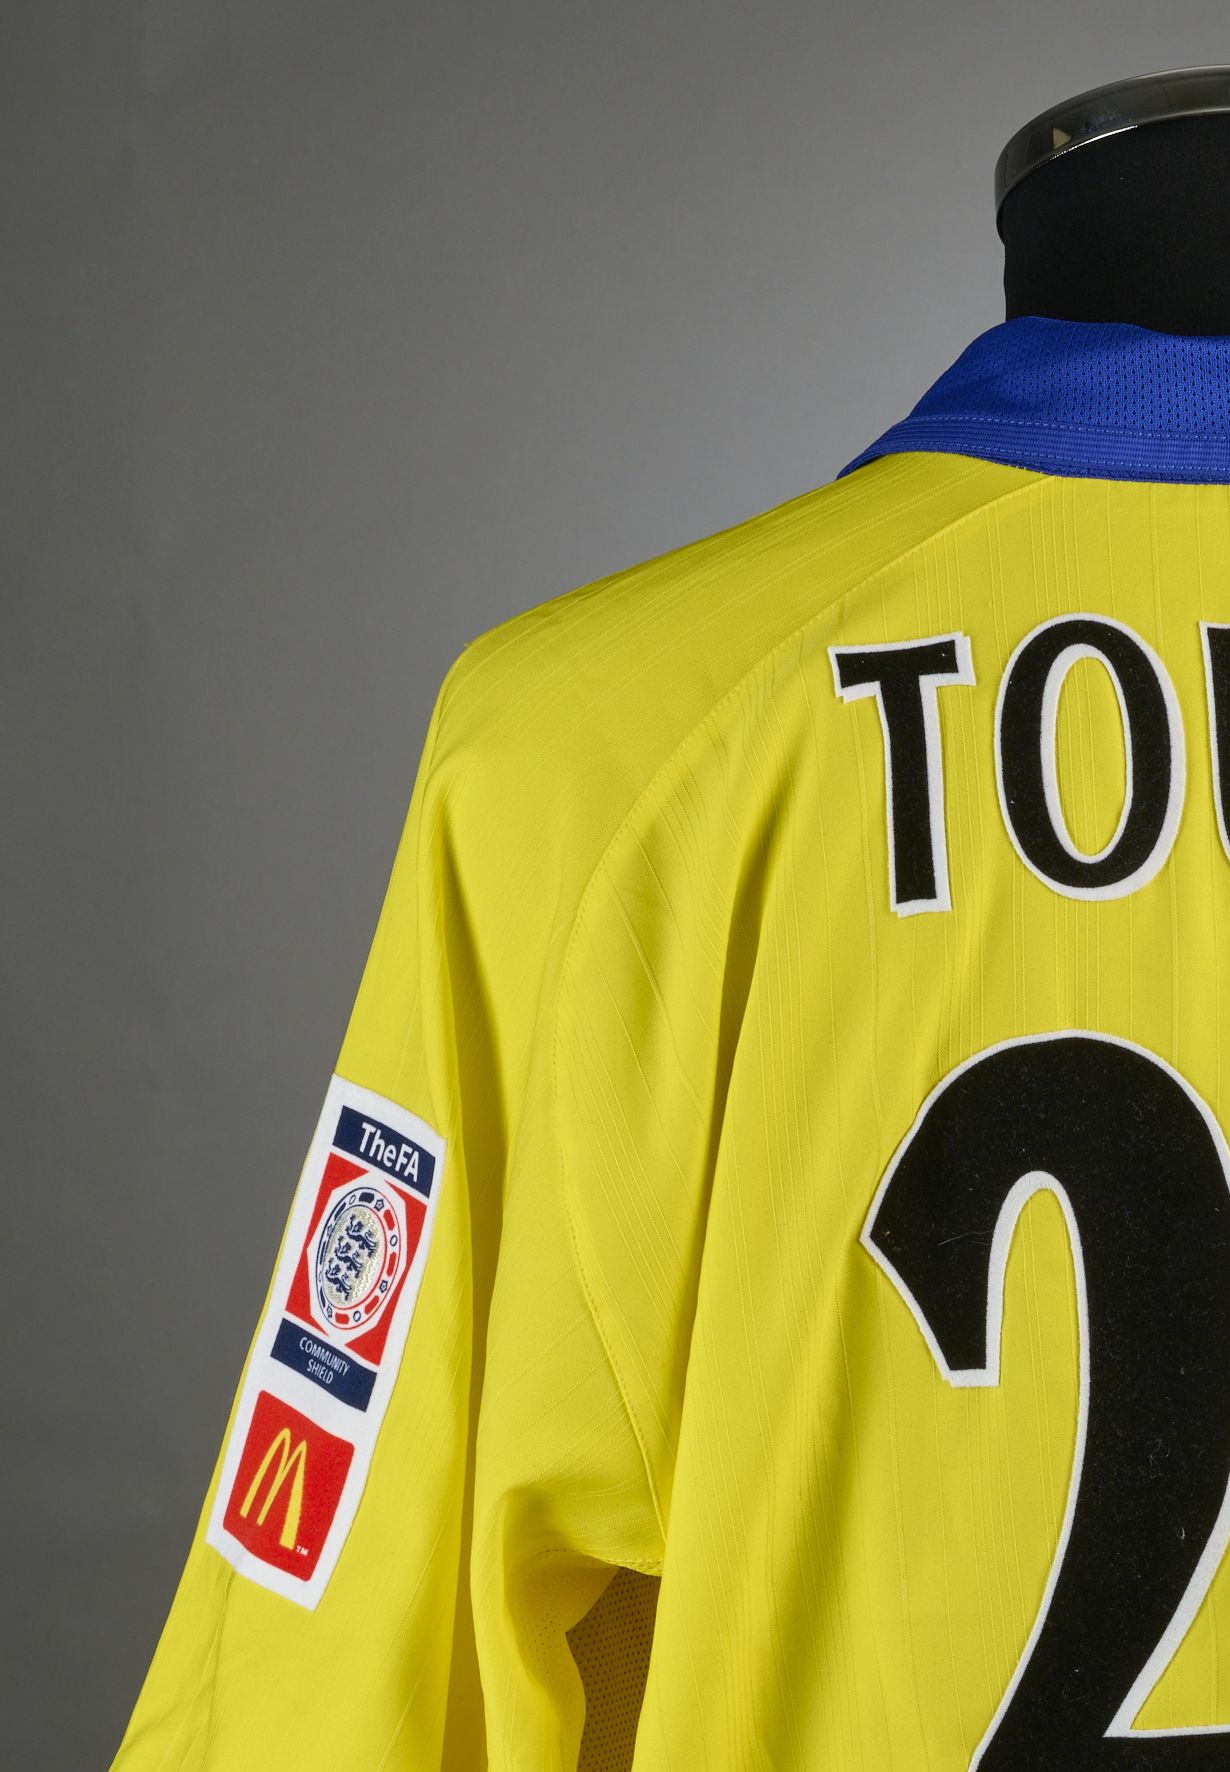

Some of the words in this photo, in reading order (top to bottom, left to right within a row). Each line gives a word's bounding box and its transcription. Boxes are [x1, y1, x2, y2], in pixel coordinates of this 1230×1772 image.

[299, 1336, 350, 1376] COMMUNITY
[306, 1358, 334, 1384] SHIELD
[296, 1545, 309, 1557] TM
